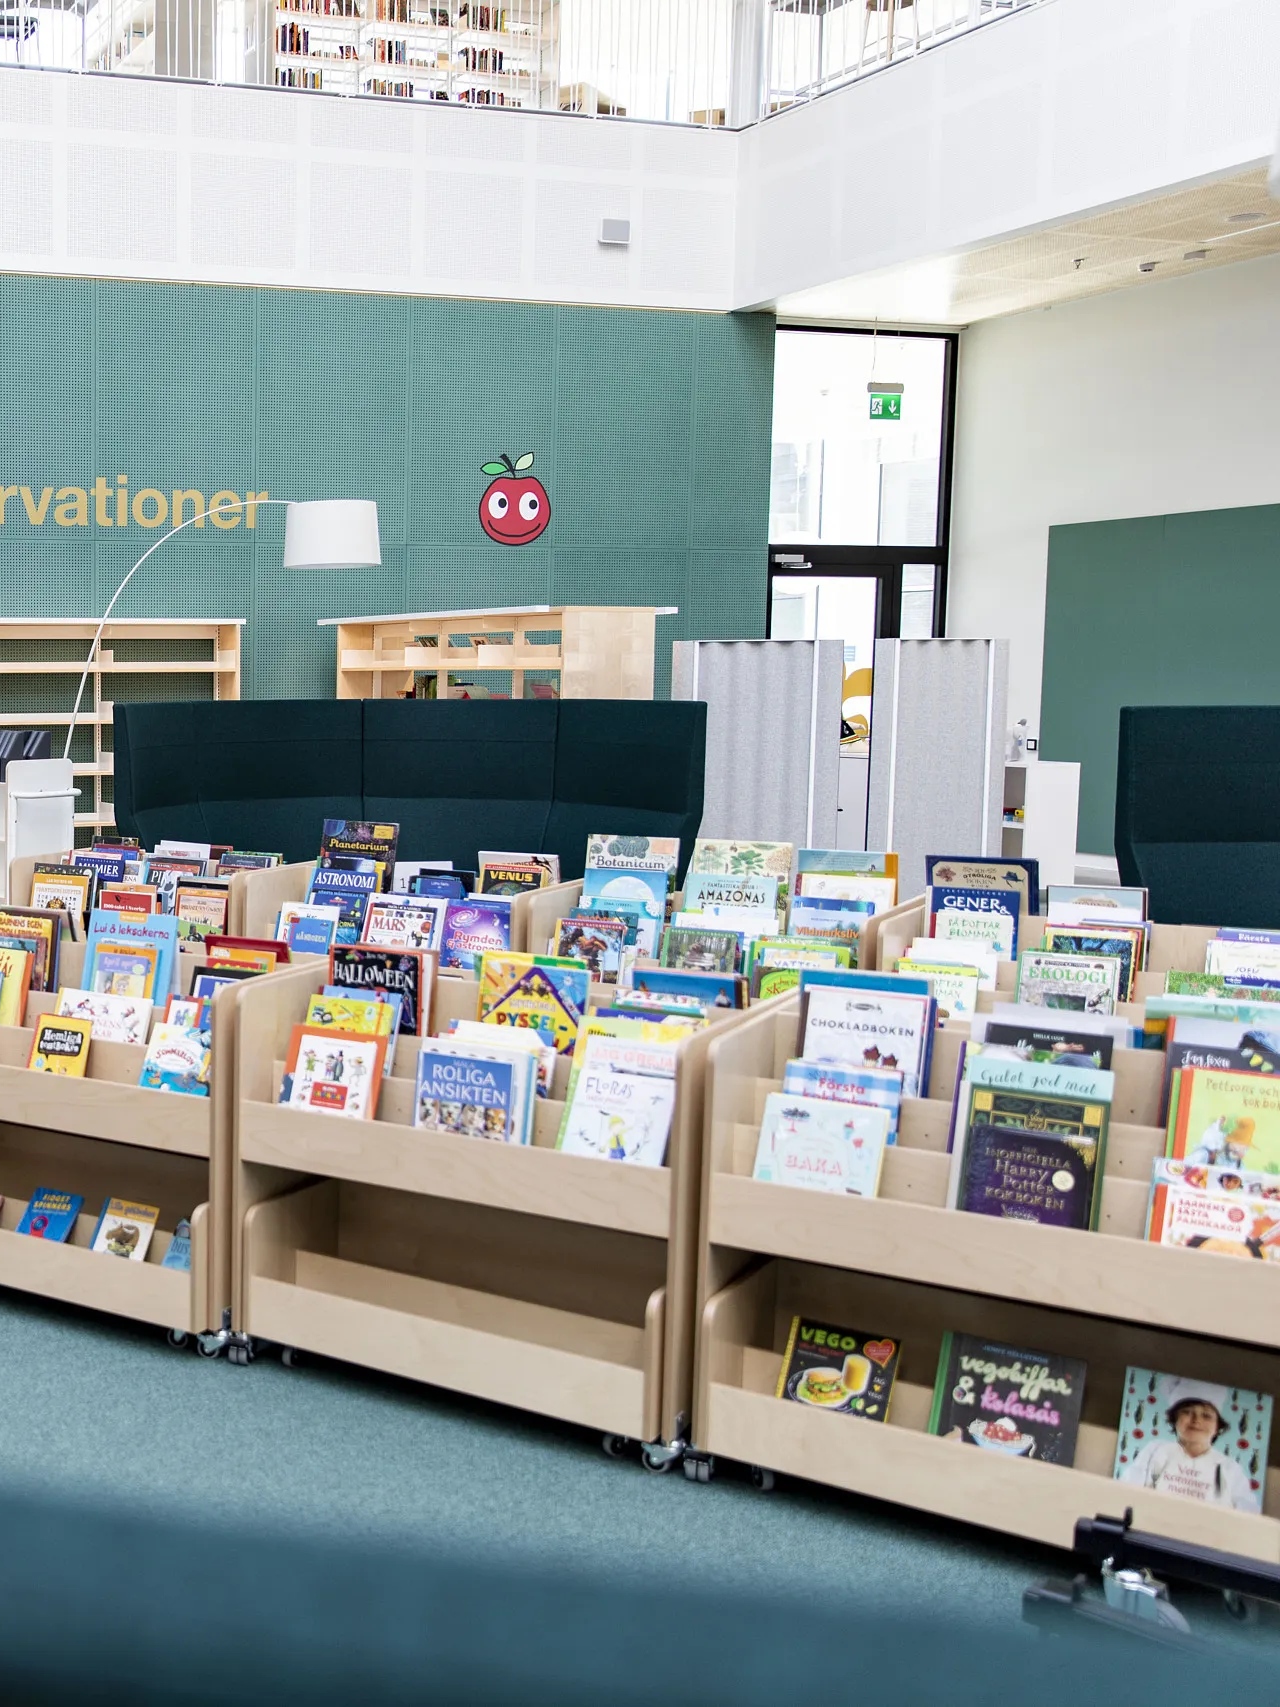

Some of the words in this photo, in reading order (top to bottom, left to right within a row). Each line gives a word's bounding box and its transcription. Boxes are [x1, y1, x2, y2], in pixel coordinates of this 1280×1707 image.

[329, 838, 389, 852] Planetarium
[596, 856, 665, 869] Botanicum
[314, 871, 376, 889] ASTRONOMI
[490, 871, 533, 882] VENUS
[697, 889, 766, 904] AMAZONAS
[943, 895, 1000, 910] GENER
[0, 918, 26, 928] BARNENS
[27, 919, 43, 929] EGEN
[94, 922, 107, 933] Lui
[119, 924, 169, 939] leksakerna
[372, 916, 406, 931] MARS
[796, 926, 859, 939] Vildmarksliv
[454, 930, 503, 946] Rymden
[333, 960, 414, 989] HALLOWEEN
[1029, 965, 1107, 984] EKOLOGI
[496, 1012, 568, 1032] PYSSEL-
[810, 1017, 915, 1037] CHOKLADBOKEN
[432, 1063, 496, 1087] ROLIGA
[981, 1068, 1023, 1084] Galet
[1031, 1073, 1060, 1090] god
[1065, 1080, 1097, 1095] mat
[420, 1082, 507, 1105] ANSIKTEN
[585, 1076, 635, 1098] FLORAS
[818, 1077, 865, 1095] Första
[800, 1326, 856, 1350] VEGO
